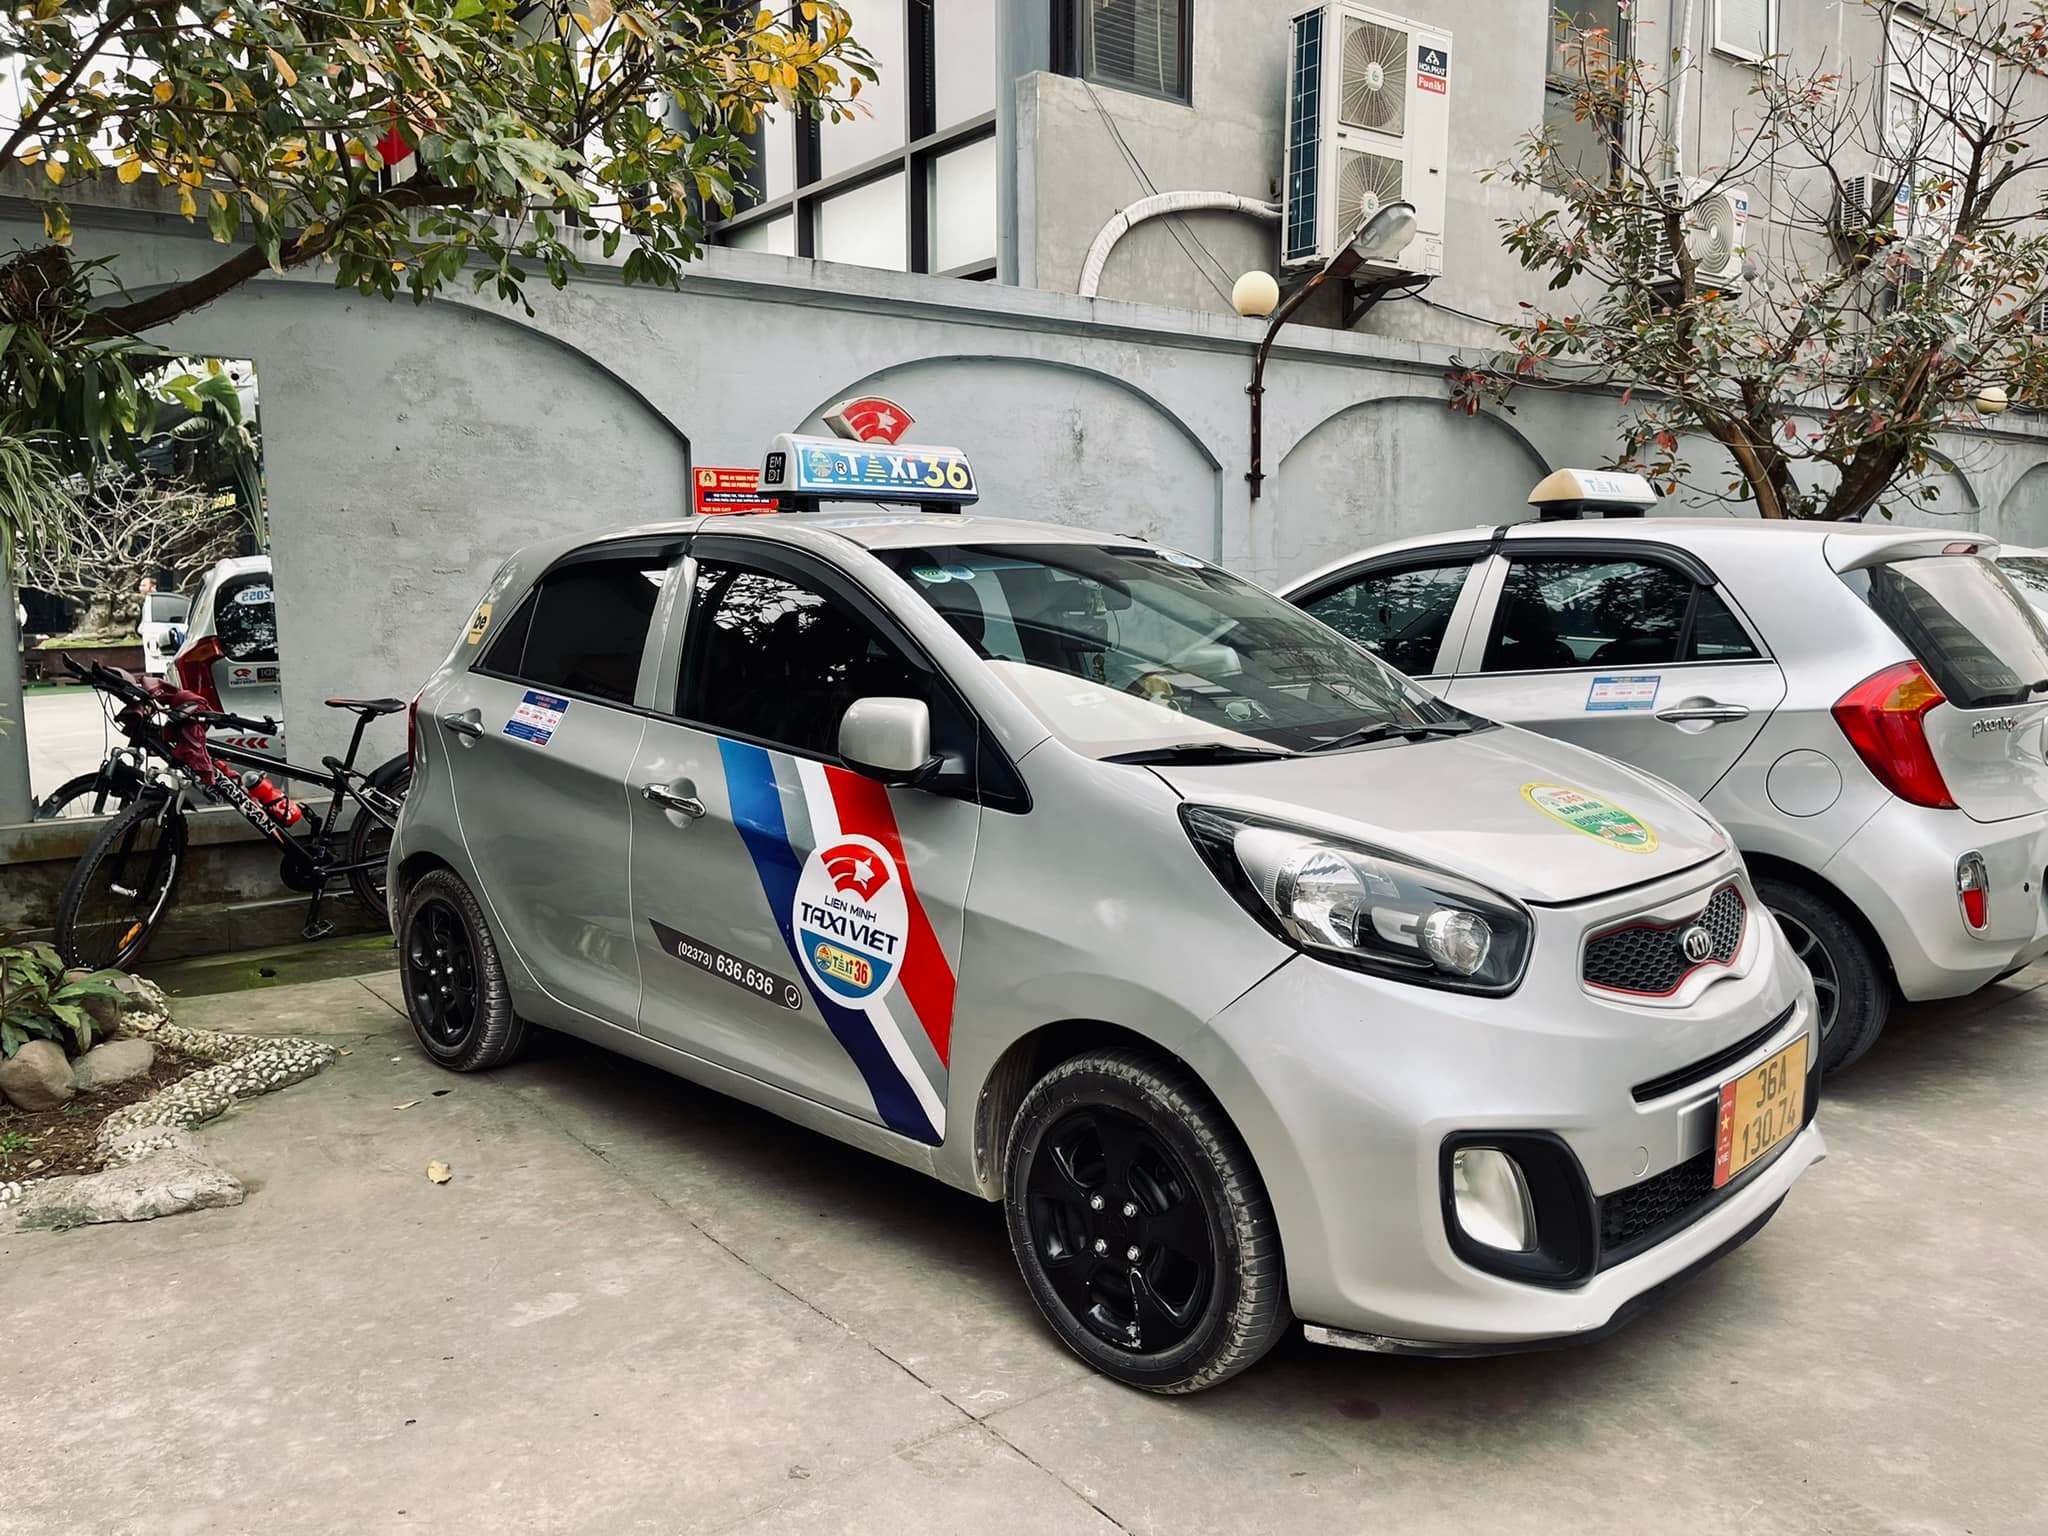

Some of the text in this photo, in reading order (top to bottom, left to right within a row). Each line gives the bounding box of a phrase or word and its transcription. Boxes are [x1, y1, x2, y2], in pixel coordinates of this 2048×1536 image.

[1418, 75, 1446, 93] Funiki
[920, 455, 969, 490] 36
[801, 902, 898, 955] TAXI VIET
[824, 895, 877, 922] LIEN MINH
[678, 940, 774, 995] (02373) 636.636
[854, 959, 868, 985] 36
[1756, 1055, 1786, 1109] 36A
[1742, 1091, 1796, 1162] 130.74
